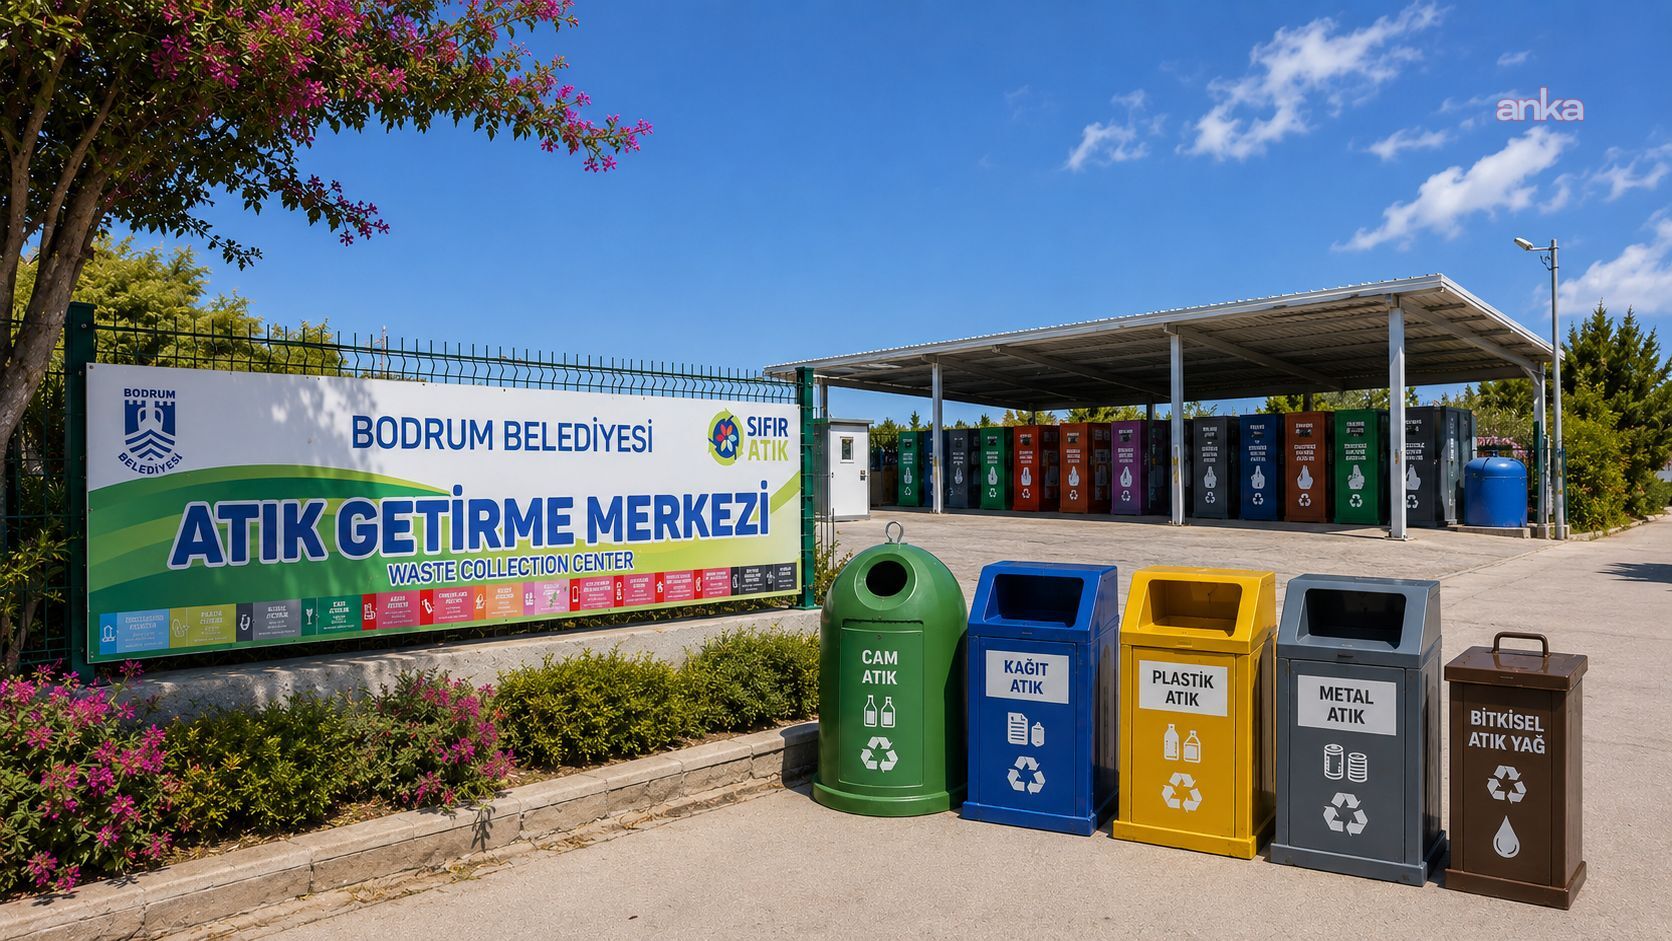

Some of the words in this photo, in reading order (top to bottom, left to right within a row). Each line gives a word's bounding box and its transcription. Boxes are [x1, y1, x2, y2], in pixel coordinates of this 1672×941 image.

[124, 388, 176, 399] BODRUM
[352, 415, 494, 450] BODRUM
[504, 417, 653, 453] BELEDİYESİ
[747, 416, 788, 437] SIFIR
[748, 439, 788, 461] ATIK
[168, 499, 328, 569] ATIK
[335, 484, 576, 559] GETİRME
[586, 479, 770, 544] MERKEZİ
[388, 561, 456, 585] WASTE
[460, 555, 569, 580] COLLECTION
[573, 551, 634, 572] CENTER
[861, 649, 898, 665] CAM
[1003, 658, 1049, 676] KAĞIT
[862, 669, 898, 685] ATIK
[1010, 679, 1044, 695] ATIK
[1152, 669, 1214, 689] PLASTİK
[1165, 690, 1200, 707] ATIK
[1319, 685, 1374, 705] METAL
[1327, 706, 1365, 725] ATIK
[1470, 707, 1544, 732] BİTKİSEL
[1468, 732, 1505, 750] ATIK
[1510, 734, 1545, 754] YAĞ
